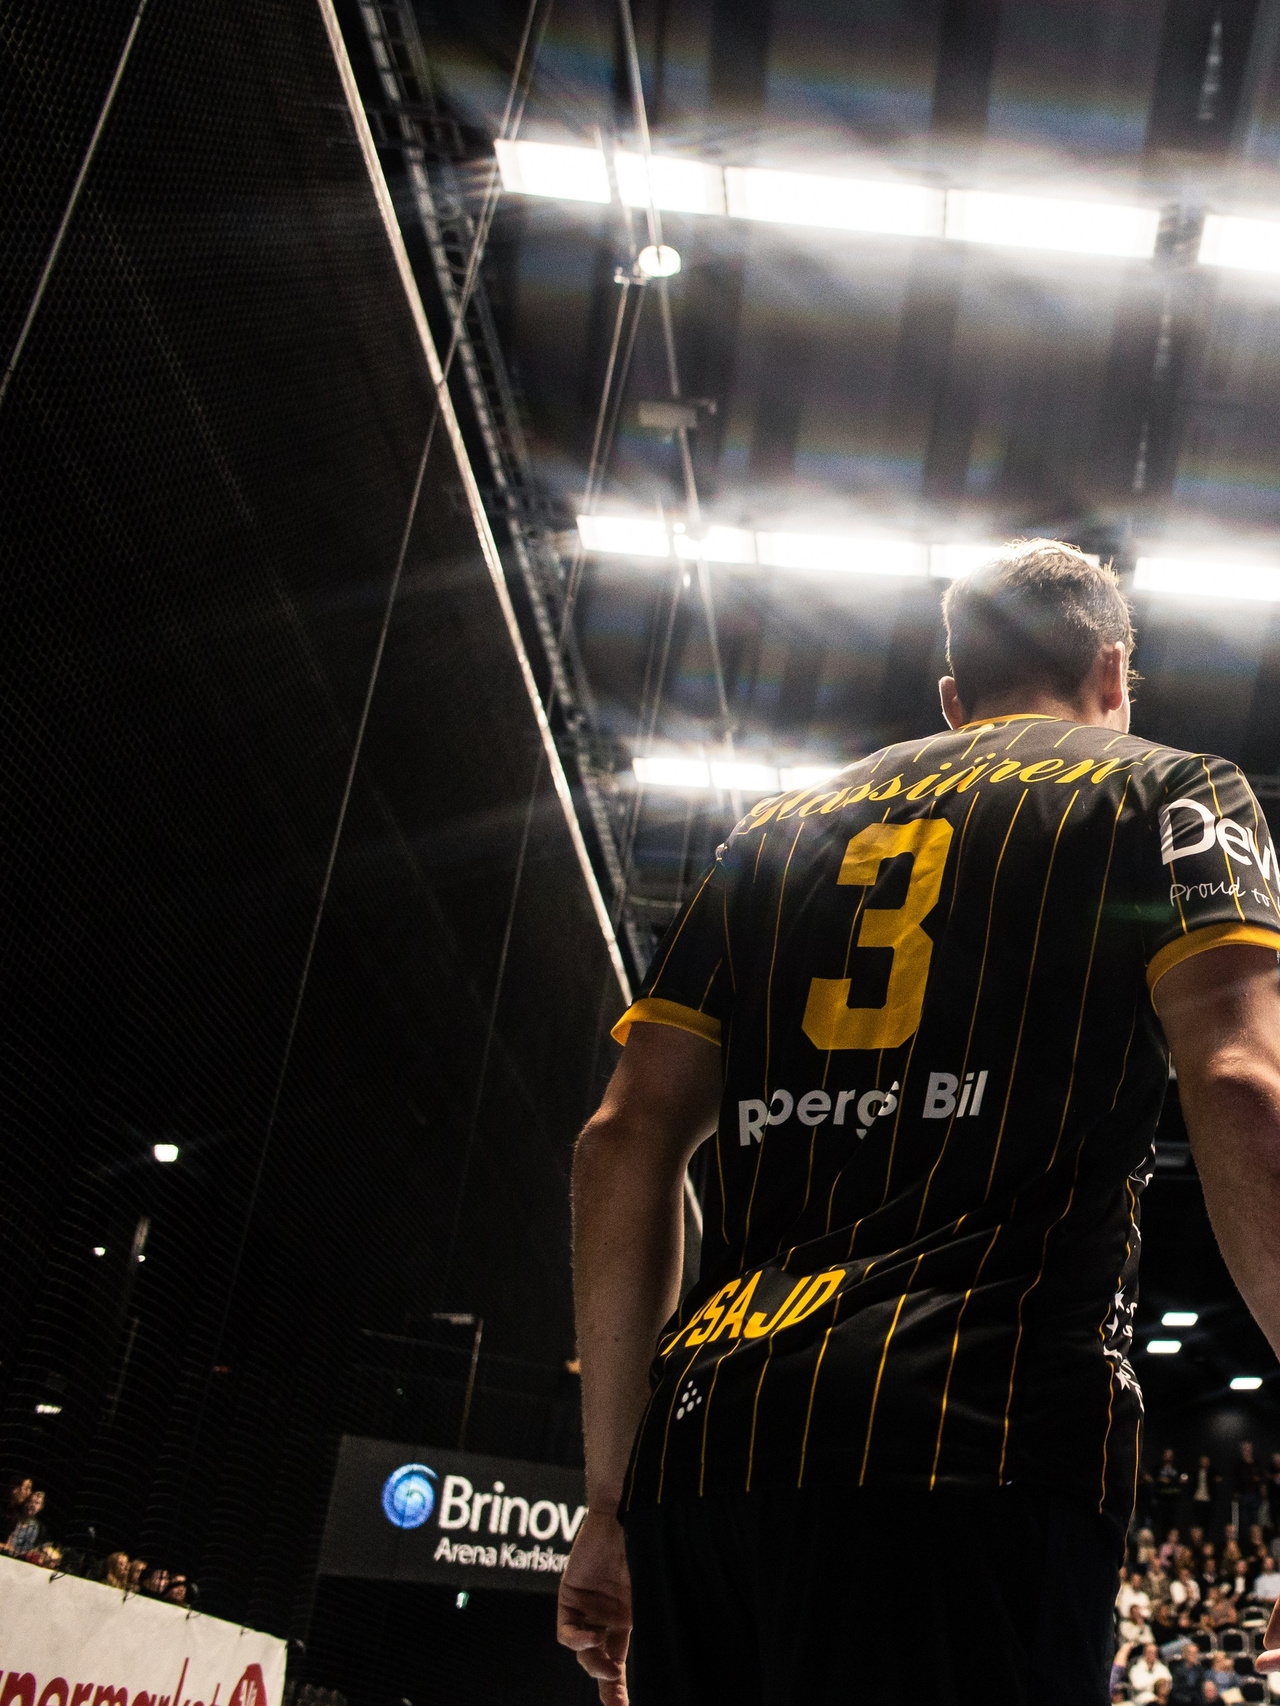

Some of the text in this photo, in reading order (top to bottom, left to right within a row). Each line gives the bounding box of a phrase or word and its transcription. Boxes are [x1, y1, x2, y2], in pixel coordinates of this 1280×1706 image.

[802, 818, 954, 1050] 3
[922, 1070, 989, 1119] Bil
[438, 1474, 589, 1542] Brinov
[433, 1536, 497, 1568] Arena
